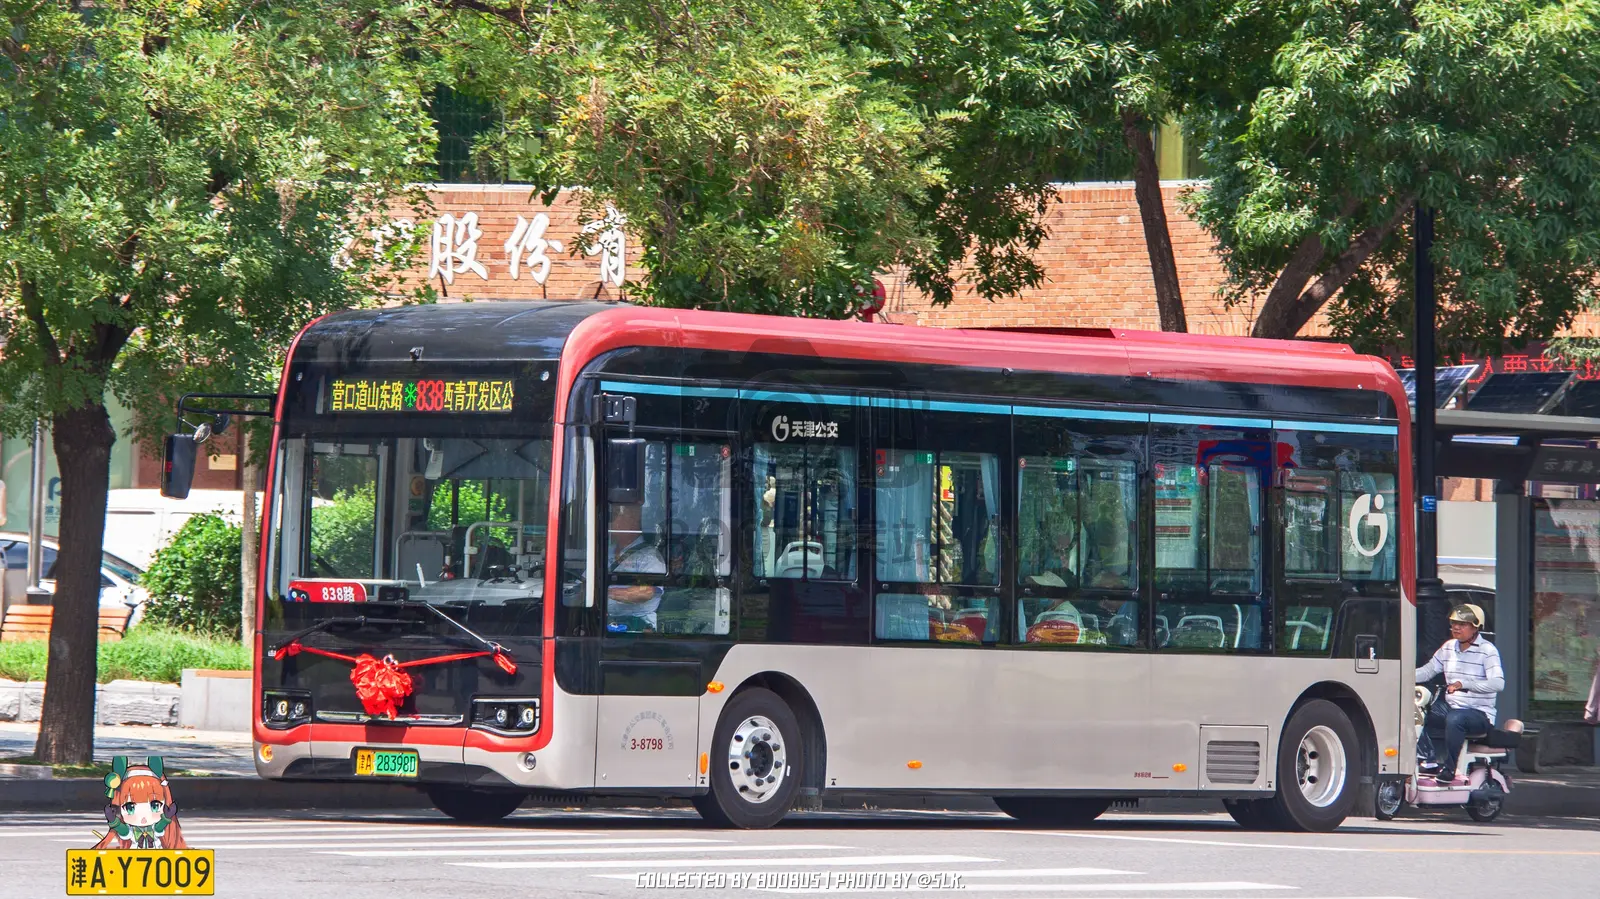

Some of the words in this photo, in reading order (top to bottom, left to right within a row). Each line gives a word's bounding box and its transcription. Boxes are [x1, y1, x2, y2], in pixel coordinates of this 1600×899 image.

[332, 380, 403, 411] 营口道山东路
[415, 380, 445, 411] 838
[791, 420, 839, 439] 天津公交
[321, 586, 355, 602] 838路
[630, 738, 663, 750] 3-8798
